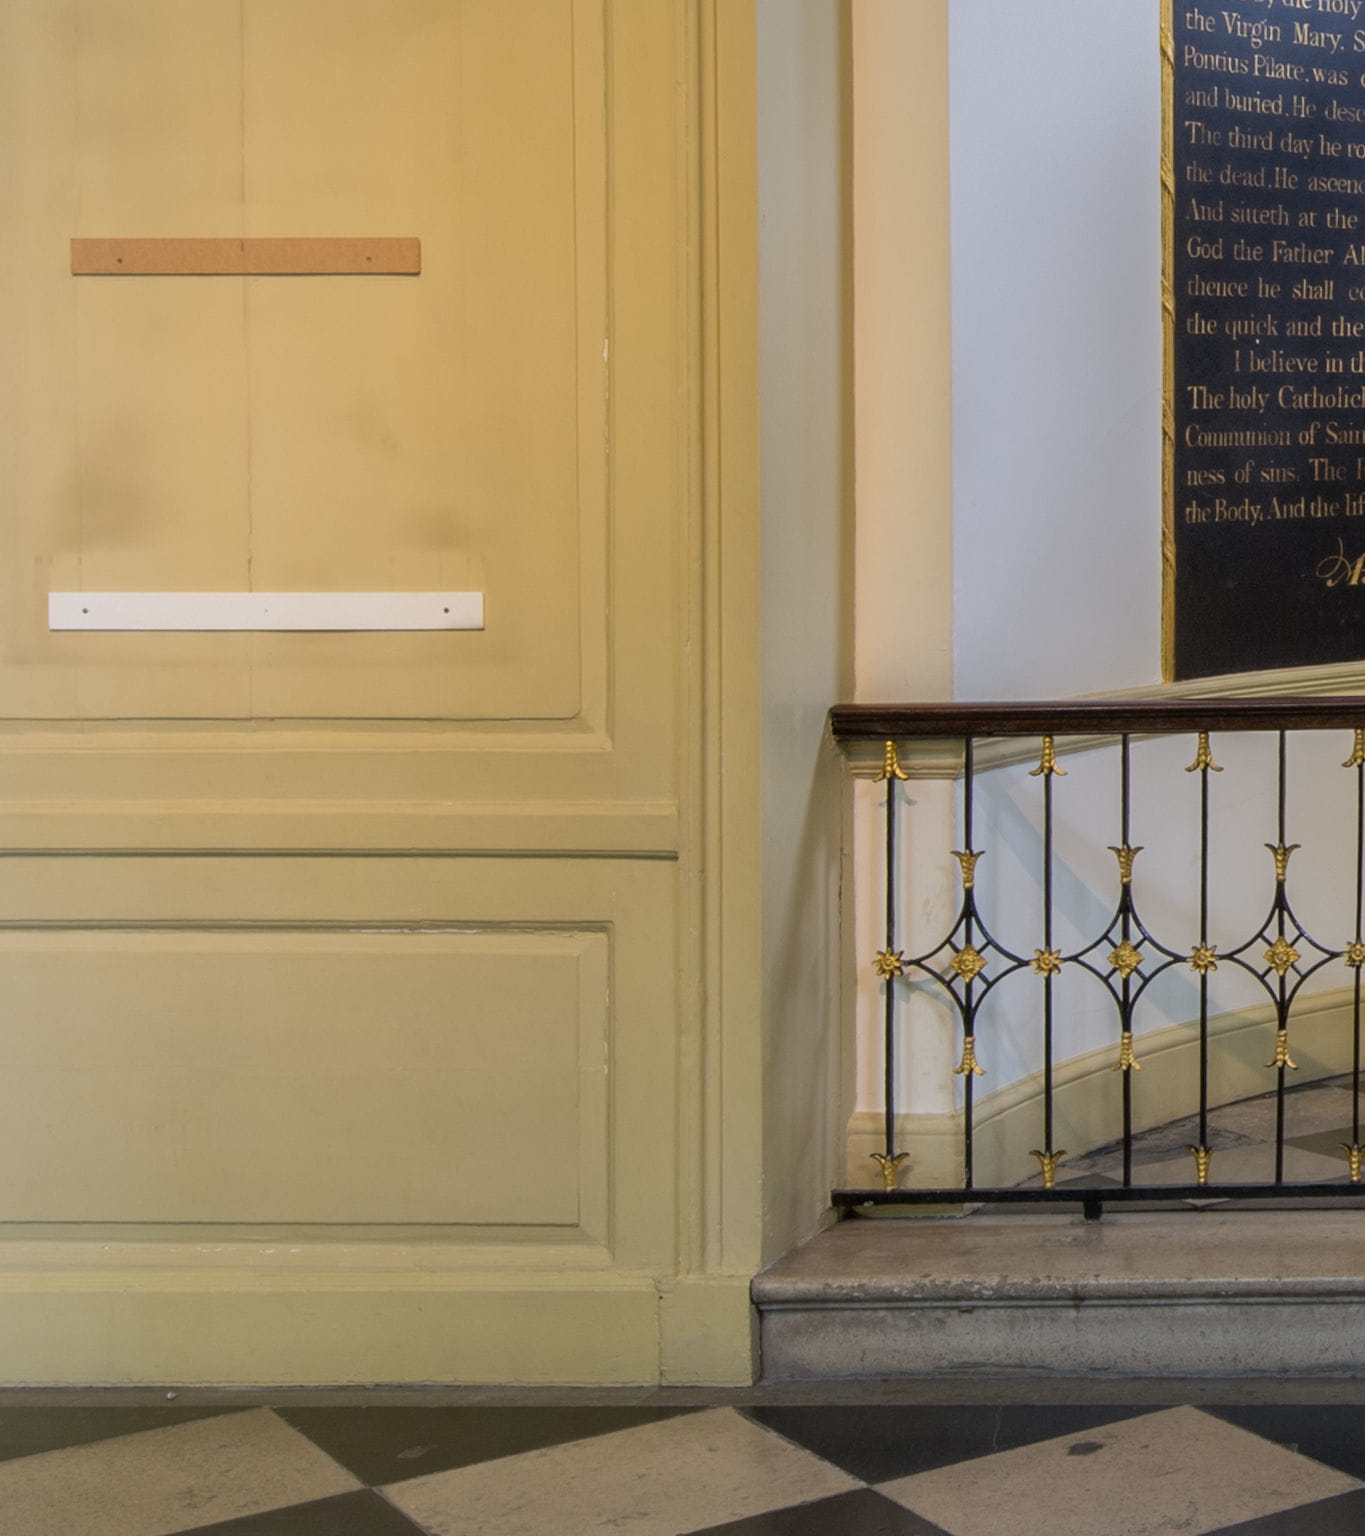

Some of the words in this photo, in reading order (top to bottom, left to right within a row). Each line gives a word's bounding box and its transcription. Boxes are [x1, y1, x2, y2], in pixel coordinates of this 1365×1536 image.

[1185, 8, 1216, 32] the
[1221, 11, 1281, 49] Virgin
[1187, 312, 1217, 335] the
[1225, 314, 1278, 340] quick
[1286, 315, 1322, 337] and
[1332, 315, 1364, 337] the
[1234, 350, 1240, 372] I
[1250, 350, 1318, 373] believe
[1325, 351, 1344, 373] in
